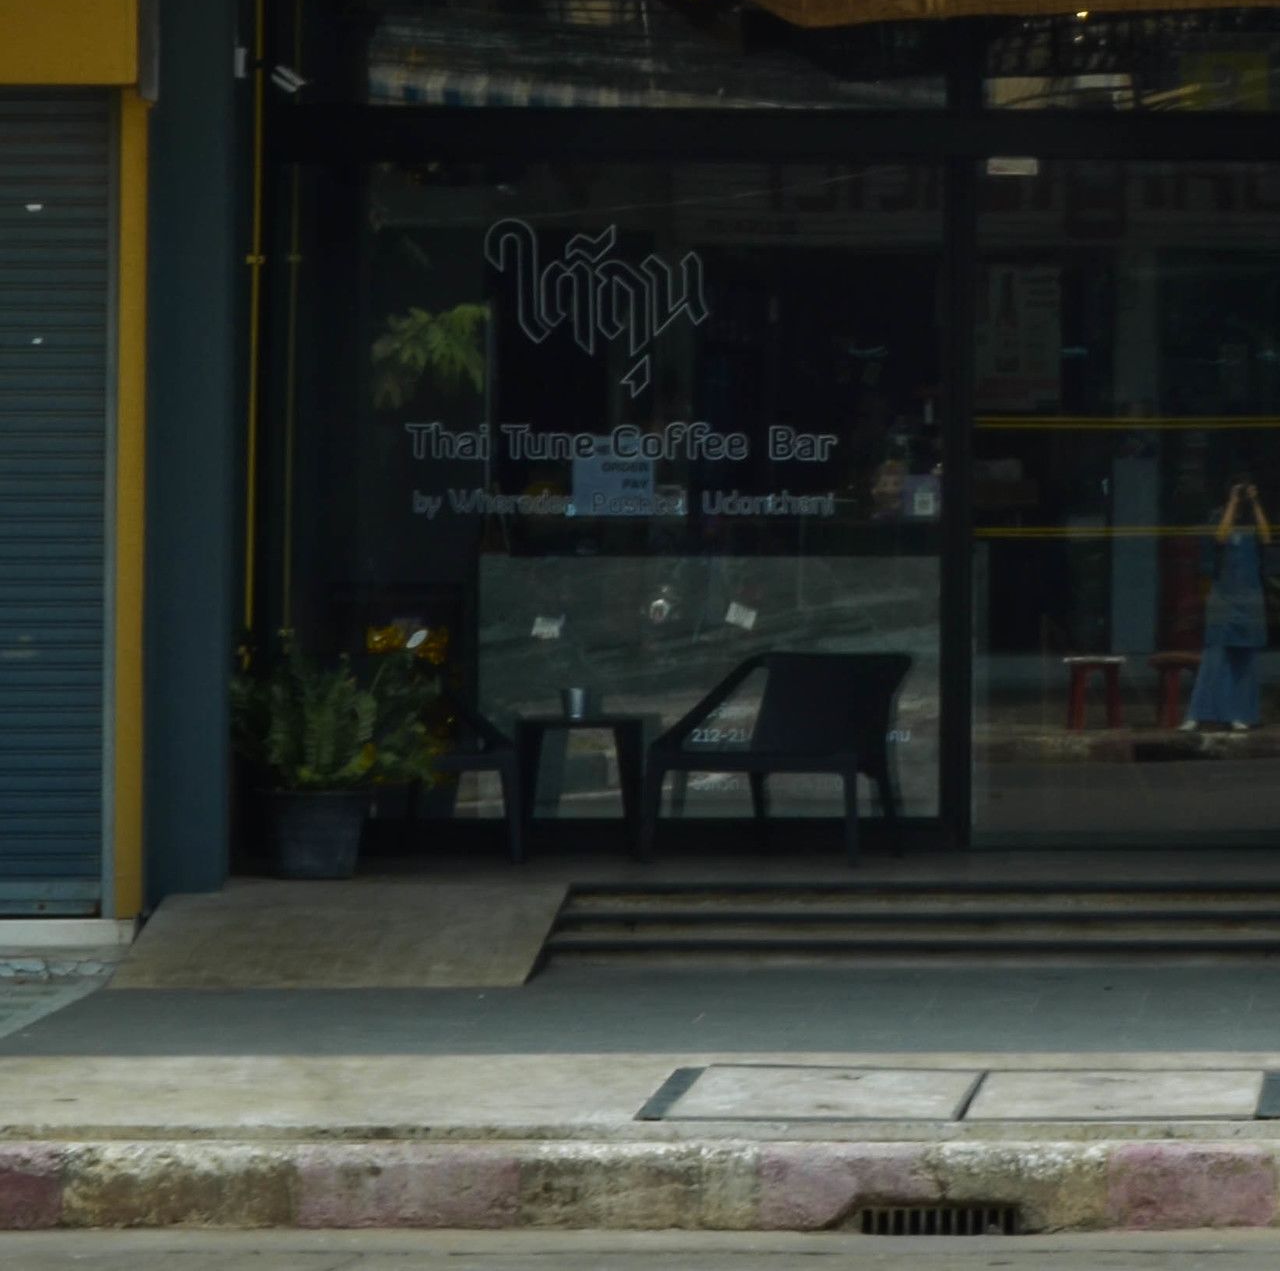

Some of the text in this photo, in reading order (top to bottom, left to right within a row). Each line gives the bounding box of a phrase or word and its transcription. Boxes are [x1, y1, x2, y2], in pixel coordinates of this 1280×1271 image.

[405, 421, 839, 462] Thai Tune Coffee Bar
[412, 491, 440, 518] by
